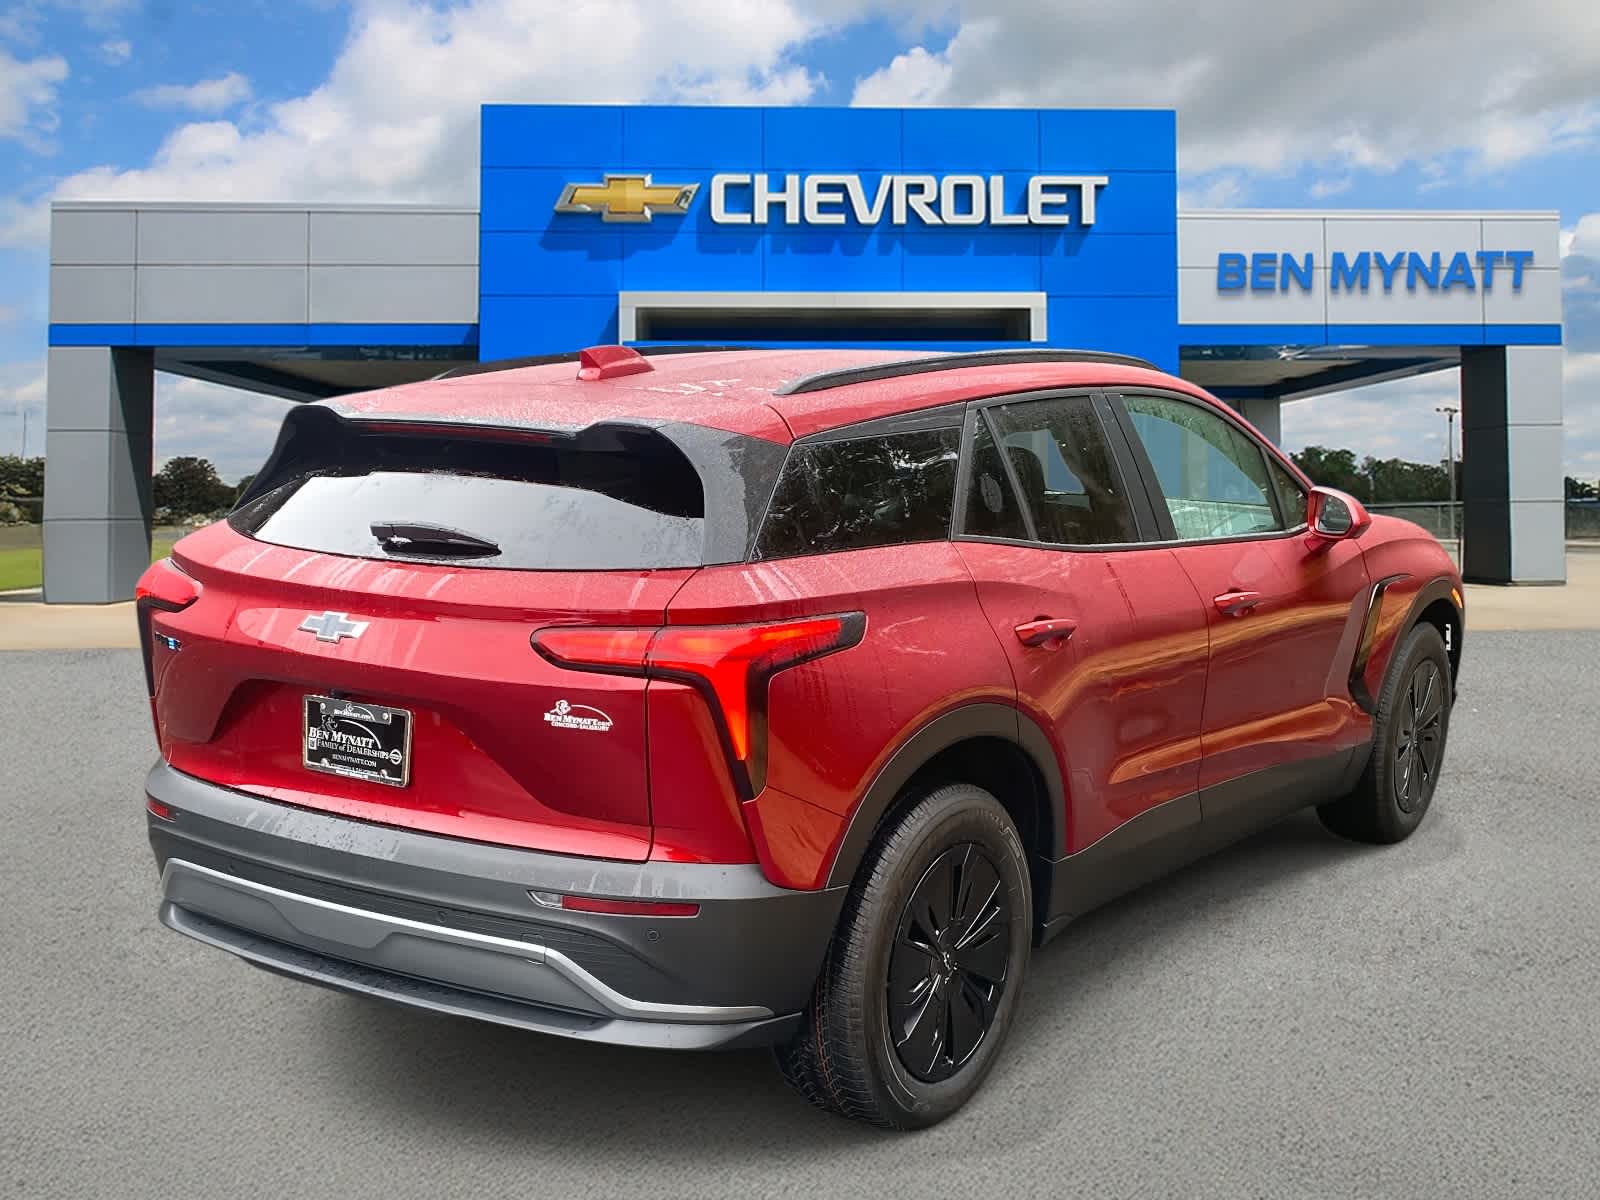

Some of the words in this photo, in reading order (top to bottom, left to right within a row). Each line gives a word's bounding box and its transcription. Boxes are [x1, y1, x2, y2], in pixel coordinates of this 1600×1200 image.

[710, 173, 1109, 227] CHEVROLET
[1216, 252, 1314, 290] BEN
[1329, 250, 1534, 290] MYNATT
[309, 727, 330, 741] BEN
[331, 730, 375, 749] MYNATT
[317, 739, 339, 752] FAMILY
[346, 744, 390, 760] DEALERSHIPS
